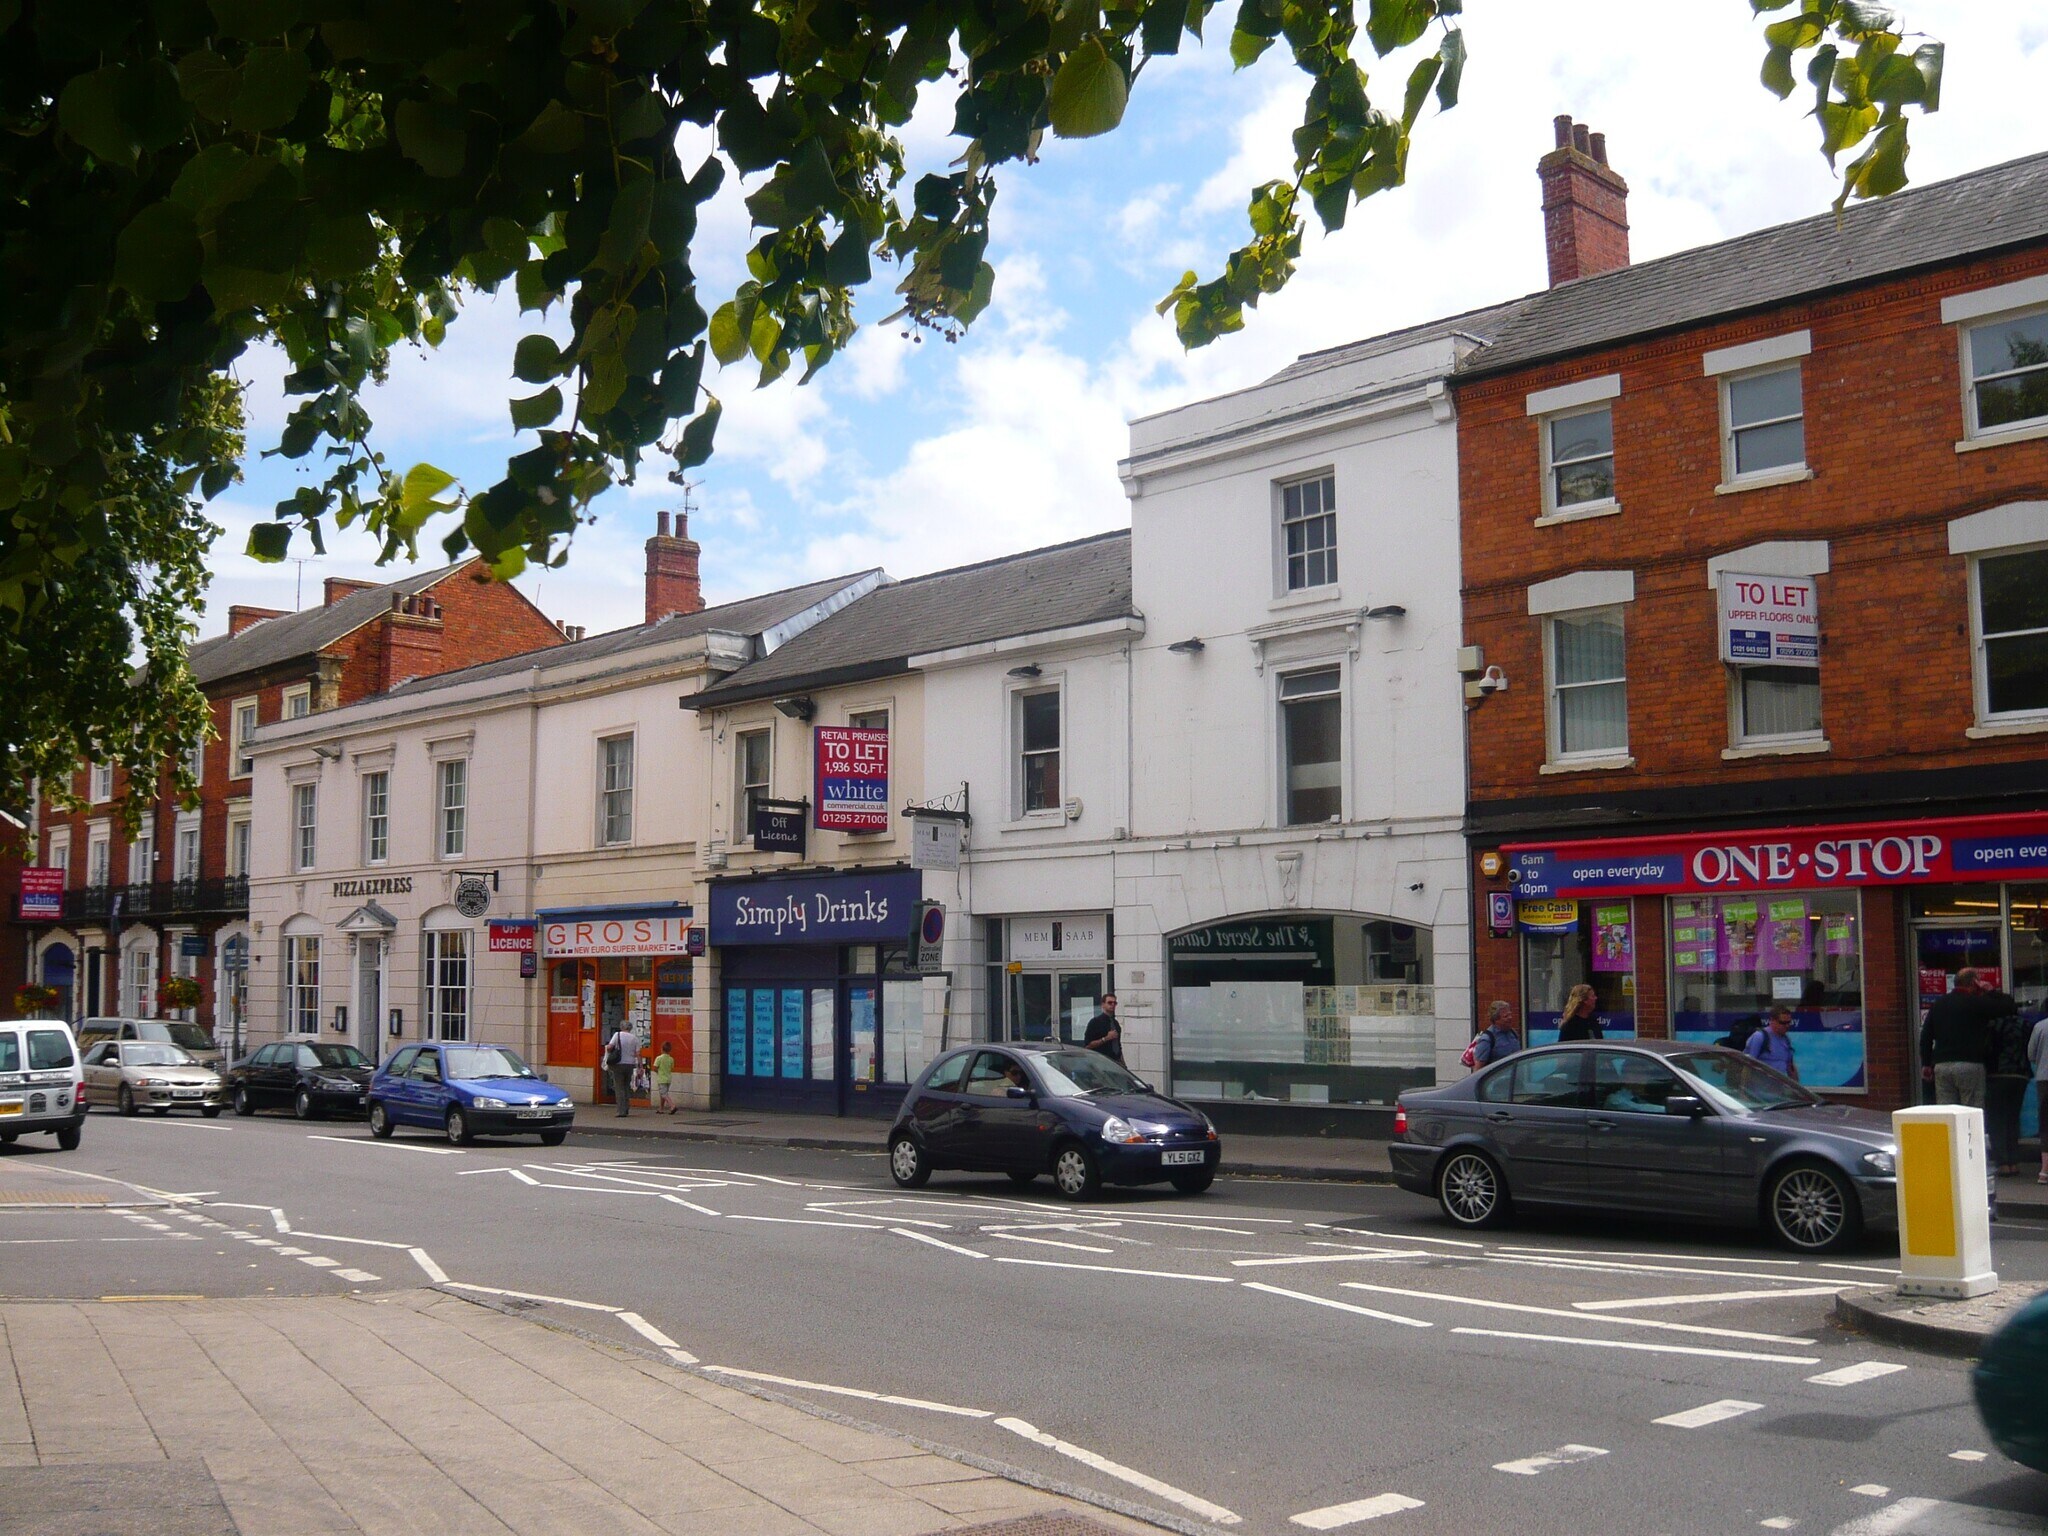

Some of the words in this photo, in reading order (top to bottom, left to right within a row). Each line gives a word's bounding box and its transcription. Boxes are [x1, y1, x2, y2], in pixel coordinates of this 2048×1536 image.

[1735, 583, 1765, 605] TO
[1772, 585, 1809, 607] LET
[1728, 610, 1757, 620] UPPER
[1760, 612, 1793, 623] FLOORS
[1796, 614, 1818, 624] ONLY
[821, 730, 850, 741] RETAIL
[852, 732, 889, 742] PREMISES
[824, 742, 850, 759] TO
[855, 743, 887, 760] LET
[824, 761, 850, 774] 1,936
[853, 762, 887, 775] SQ.FT.
[828, 779, 884, 800] white
[827, 802, 885, 810] commercial.co.uk
[771, 816, 788, 828] Off
[822, 813, 852, 823] 01295
[854, 814, 888, 824] 271000
[760, 829, 799, 842] Licence
[1521, 855, 1544, 865] 6am
[1973, 847, 2014, 863] open
[1527, 869, 1539, 879] to
[1573, 867, 1604, 881] open
[1607, 863, 1665, 879] everyday
[1519, 883, 1548, 895] 10pm
[25, 893, 58, 904] white
[735, 894, 807, 935] Simply
[815, 890, 888, 923] Drinks
[1522, 903, 1545, 913] Free
[1547, 902, 1574, 912] Cash
[547, 918, 693, 946] GROSIK
[1024, 932, 1048, 942] MEM
[1066, 931, 1094, 941] SAAB
[490, 938, 533, 949] LICENCE
[591, 946, 610, 954] EURO
[612, 945, 636, 953] SUPER
[637, 944, 668, 952] MARKET
[920, 952, 940, 962] ZONE
[1920, 969, 1945, 977] OPEN
[1168, 1153, 1186, 1163] YL51
